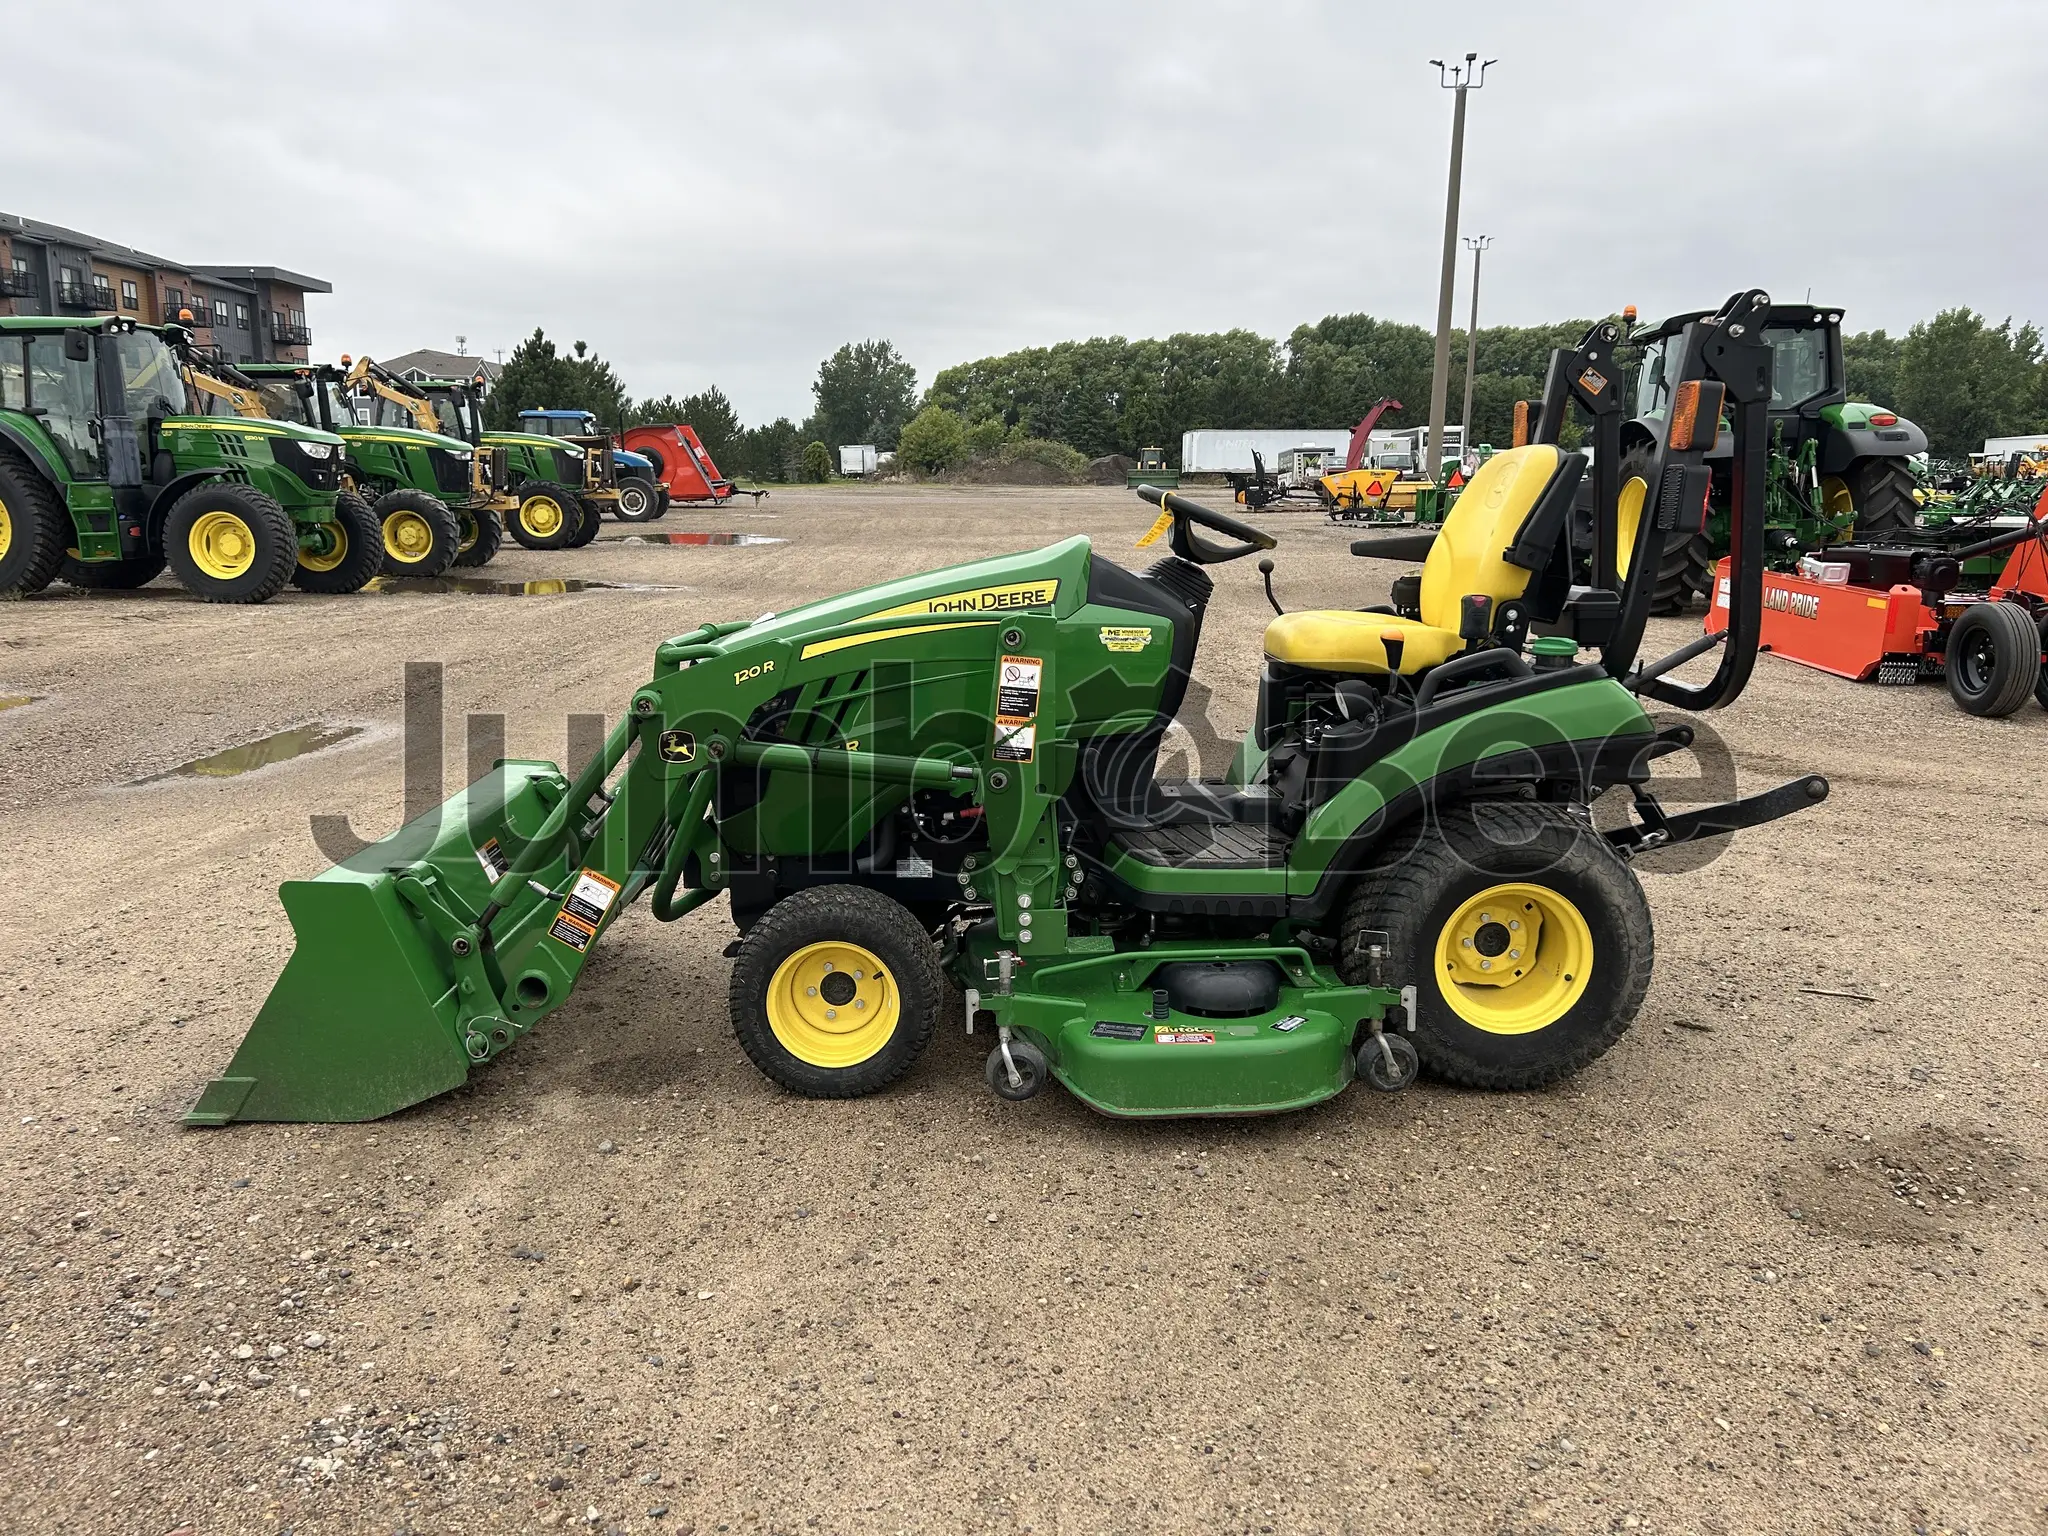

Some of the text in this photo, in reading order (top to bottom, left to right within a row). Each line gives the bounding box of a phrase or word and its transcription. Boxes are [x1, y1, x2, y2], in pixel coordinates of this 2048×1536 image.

[929, 589, 1046, 613] JOHN DEERE
[1763, 586, 1789, 613] LAND
[1789, 592, 1820, 620] PRIDE
[1009, 657, 1040, 665] WARNING
[733, 660, 775, 686] 120 R
[592, 873, 616, 889] WARNING
[567, 917, 592, 933] WARNING
